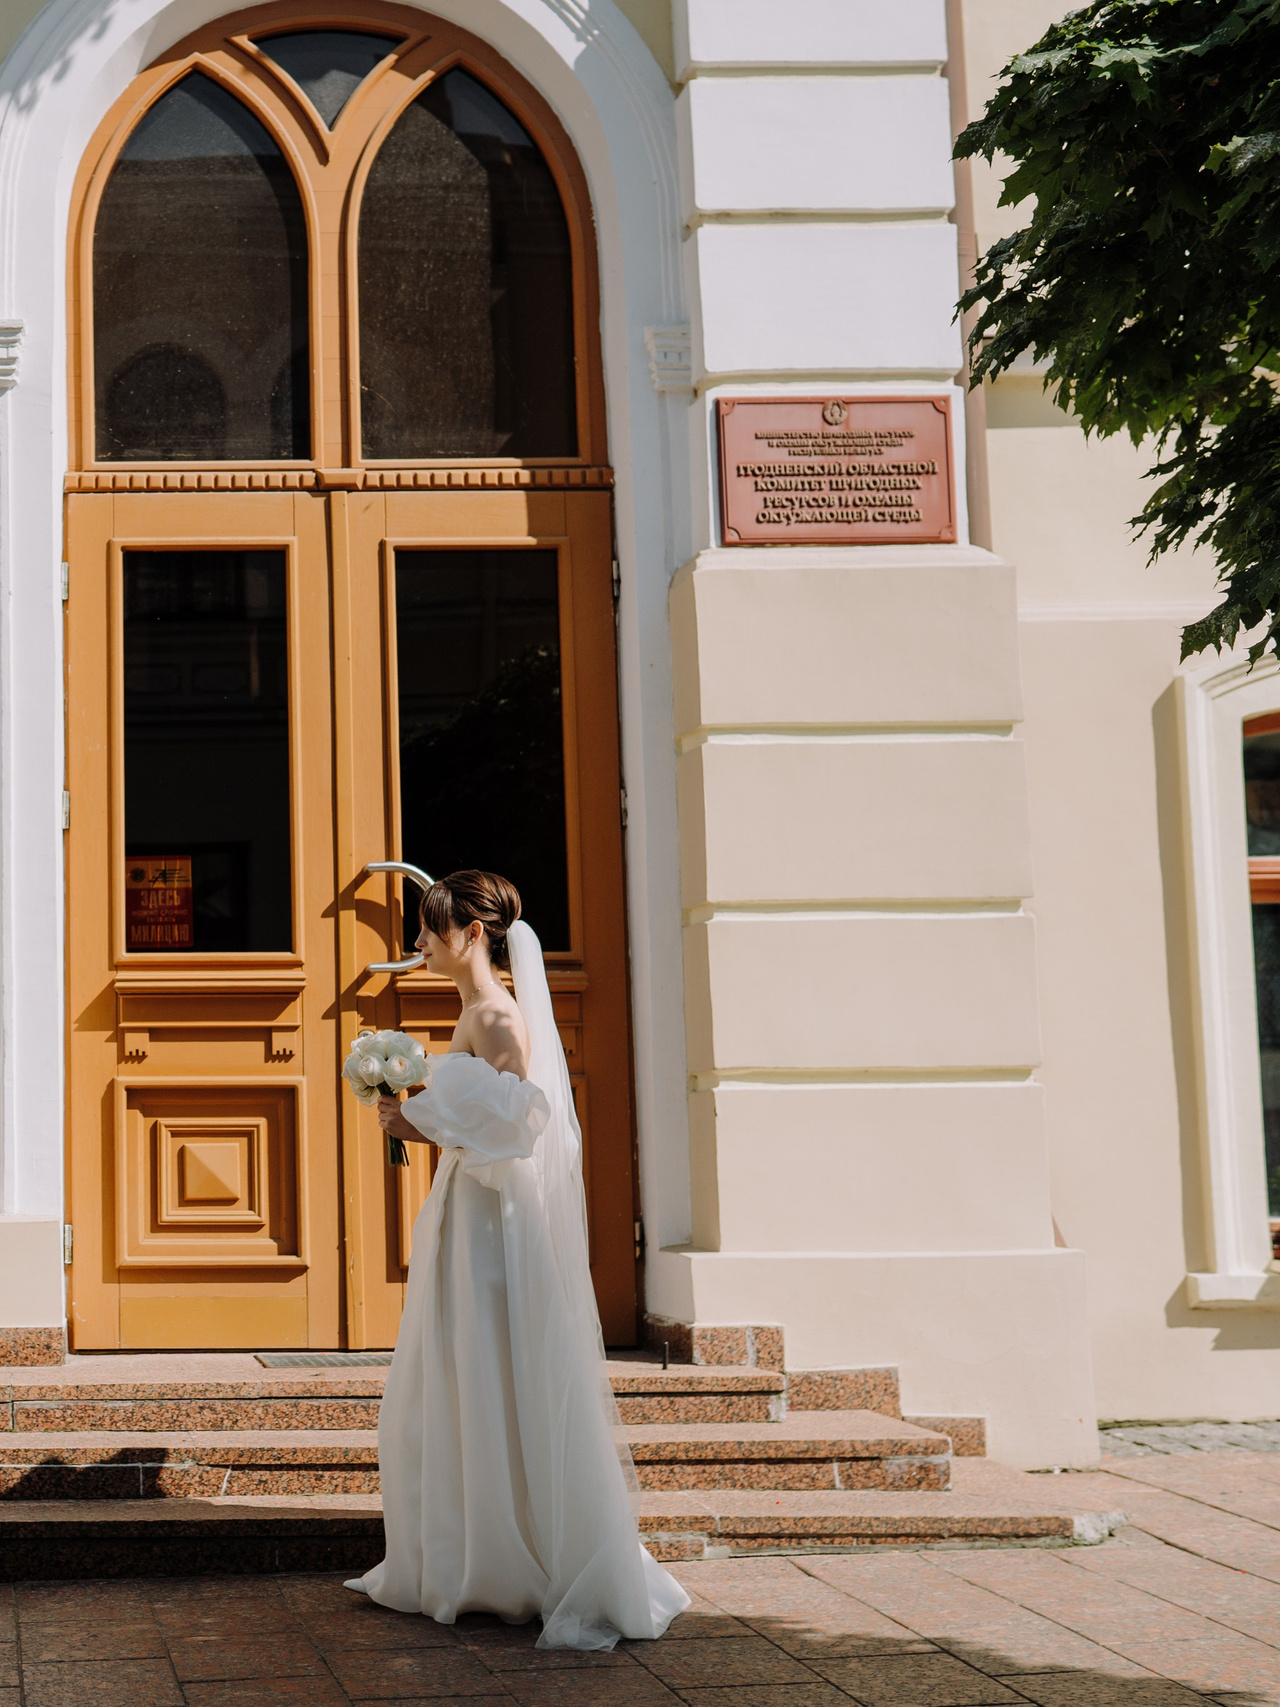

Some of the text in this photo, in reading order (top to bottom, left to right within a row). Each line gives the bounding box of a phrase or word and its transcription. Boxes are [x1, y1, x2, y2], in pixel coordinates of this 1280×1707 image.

[737, 459, 938, 477] ГРОДНЕНСКИЙ ОБЛАСТНОЙ
[754, 476, 923, 492] КОМИТЕТ ПРИРОДНЫХ
[763, 492, 914, 510] РЕСУРСОВ И ОХРАНЫ
[756, 508, 923, 526] ОКРУЖАЮЩЕЙ СРЕДЫ
[140, 890, 181, 909] ЗДЕСЬ
[131, 924, 189, 944] МИЛИЦИЮ
